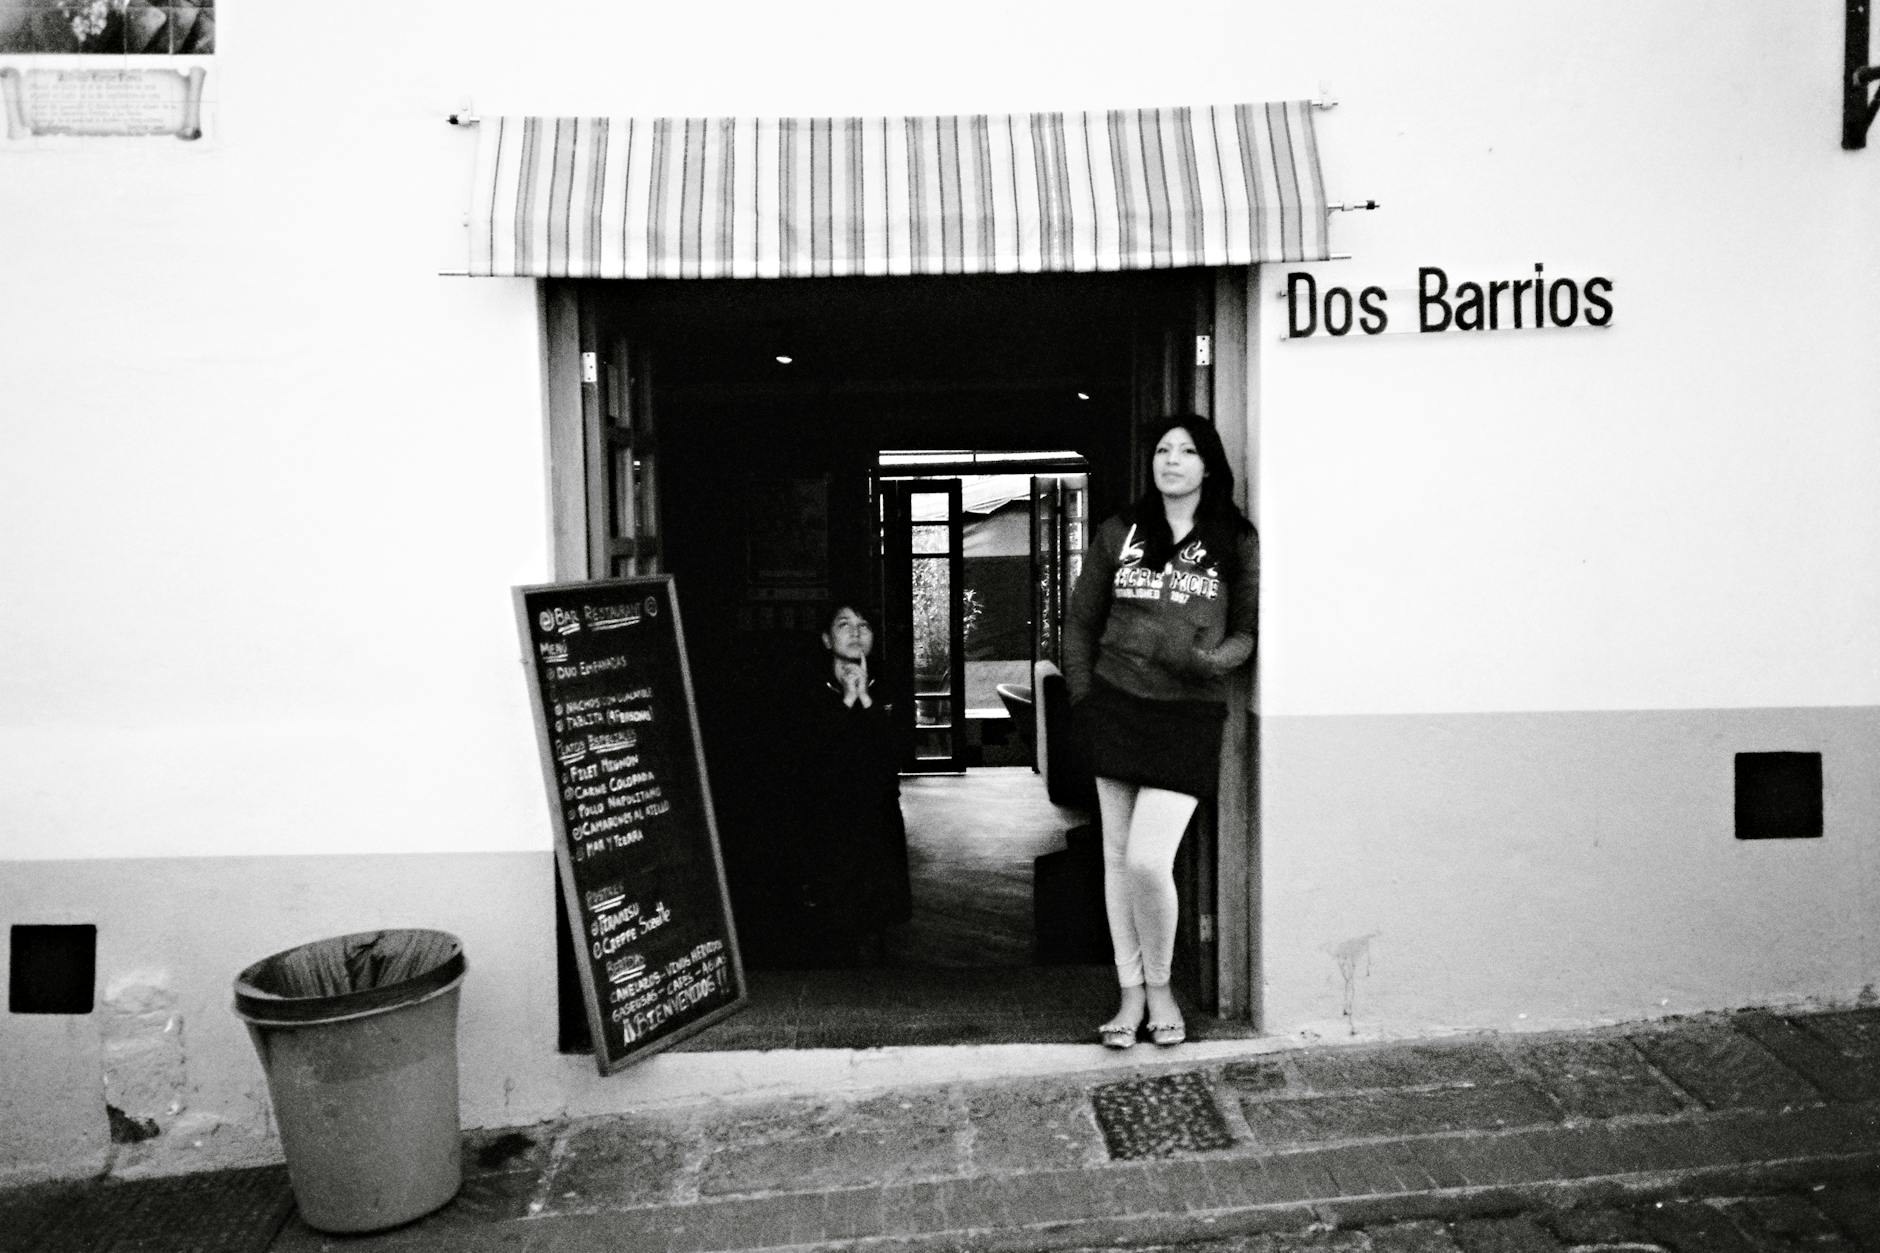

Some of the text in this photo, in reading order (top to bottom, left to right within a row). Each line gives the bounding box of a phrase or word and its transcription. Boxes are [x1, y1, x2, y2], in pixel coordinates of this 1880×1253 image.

[1287, 262, 1613, 338] Dos Barrios
[570, 763, 597, 783] FILET
[574, 783, 607, 800] CARNE
[578, 802, 605, 819] POLLO
